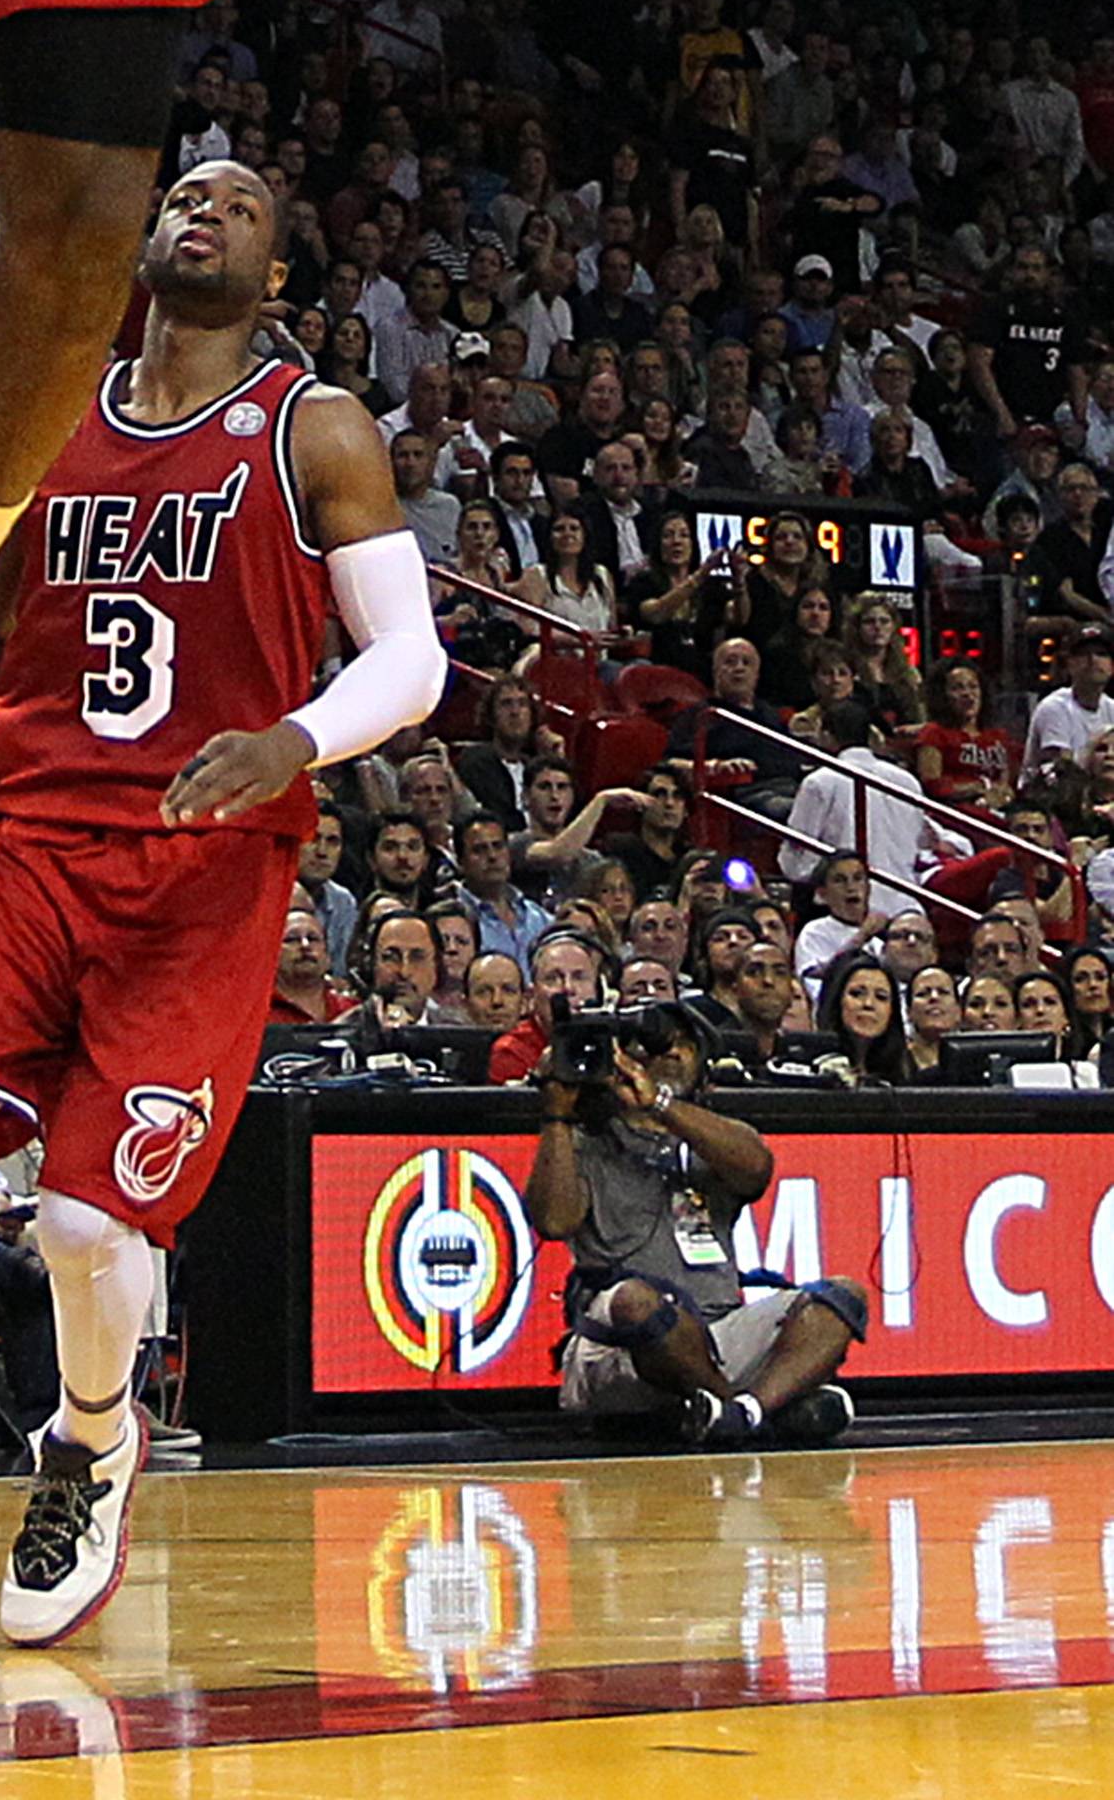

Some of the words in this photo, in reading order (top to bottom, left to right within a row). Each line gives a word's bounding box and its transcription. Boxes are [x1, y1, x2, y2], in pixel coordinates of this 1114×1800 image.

[1044, 347, 1061, 372] 3
[46, 461, 251, 585] HEAT
[82, 592, 175, 741] 3
[732, 1173, 1114, 1328] MIC
